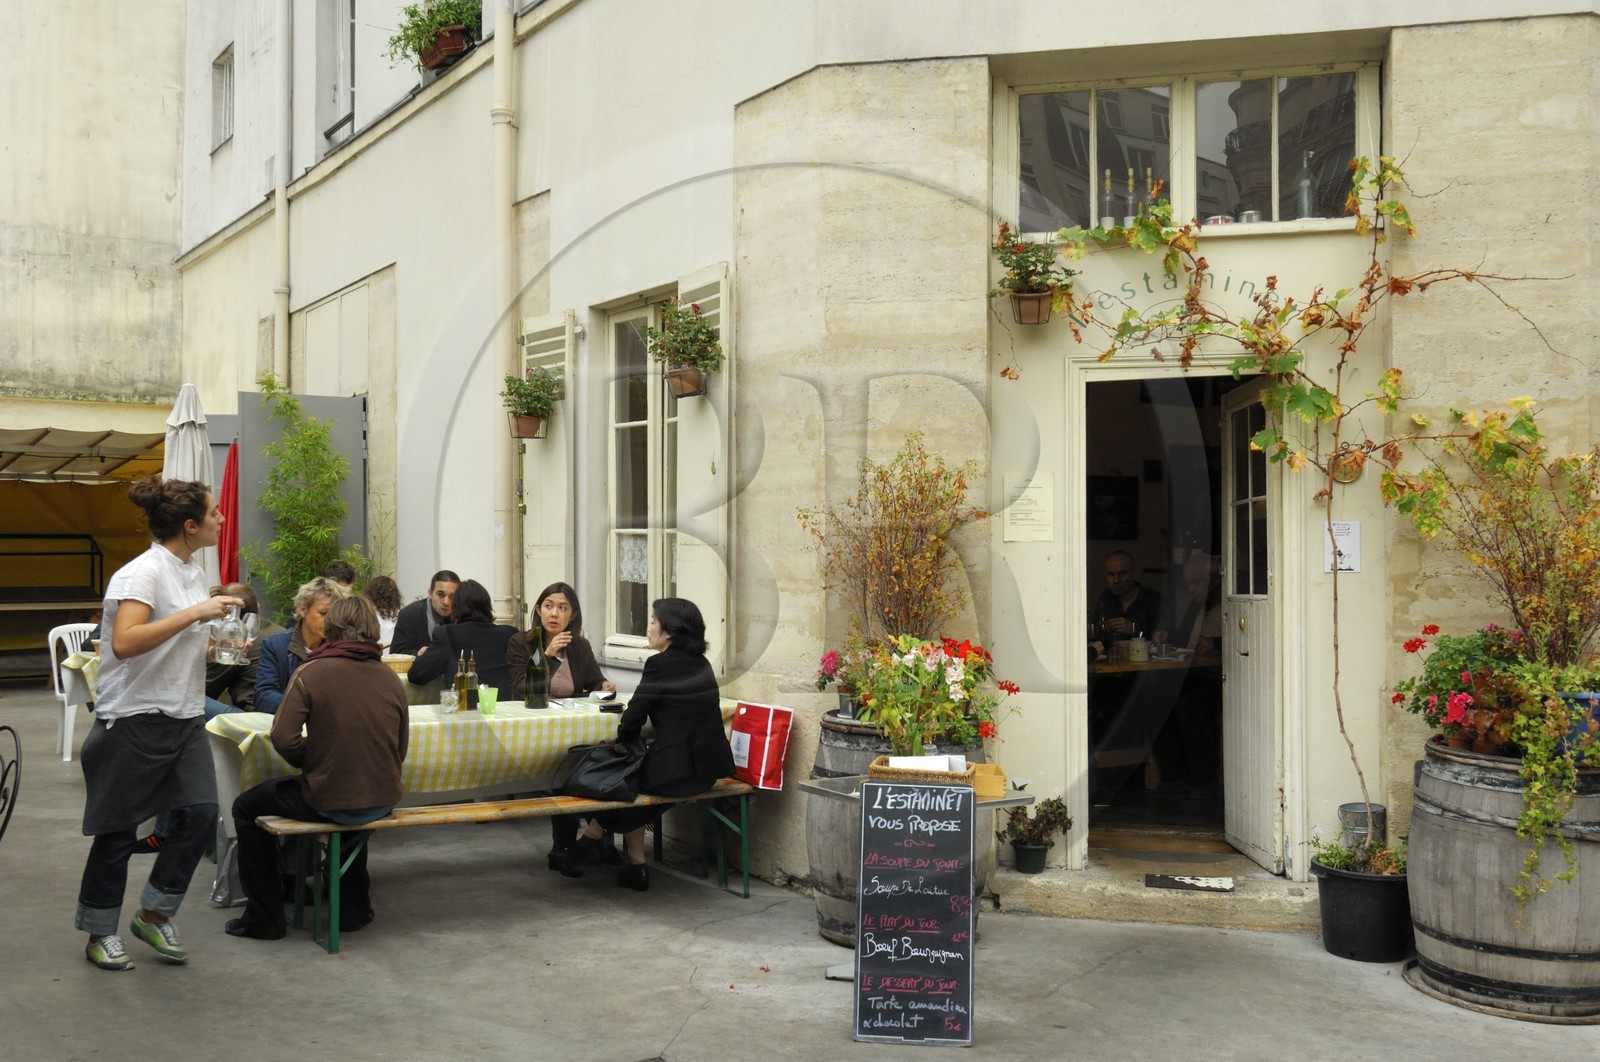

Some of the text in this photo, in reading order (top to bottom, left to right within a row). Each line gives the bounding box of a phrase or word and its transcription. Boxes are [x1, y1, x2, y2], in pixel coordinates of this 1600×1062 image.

[869, 815, 961, 836] VOUS PROPOSE
[864, 853, 878, 865] LA
[881, 856, 911, 868] SOUPE
[914, 858, 929, 868] DU
[864, 914, 875, 925] LE
[880, 914, 902, 928] PLAT
[900, 916, 914, 929] DU
[863, 974, 873, 985] LE
[878, 976, 923, 989] DESSERT
[921, 979, 935, 990] DU
[867, 995, 903, 1009] Tarte
